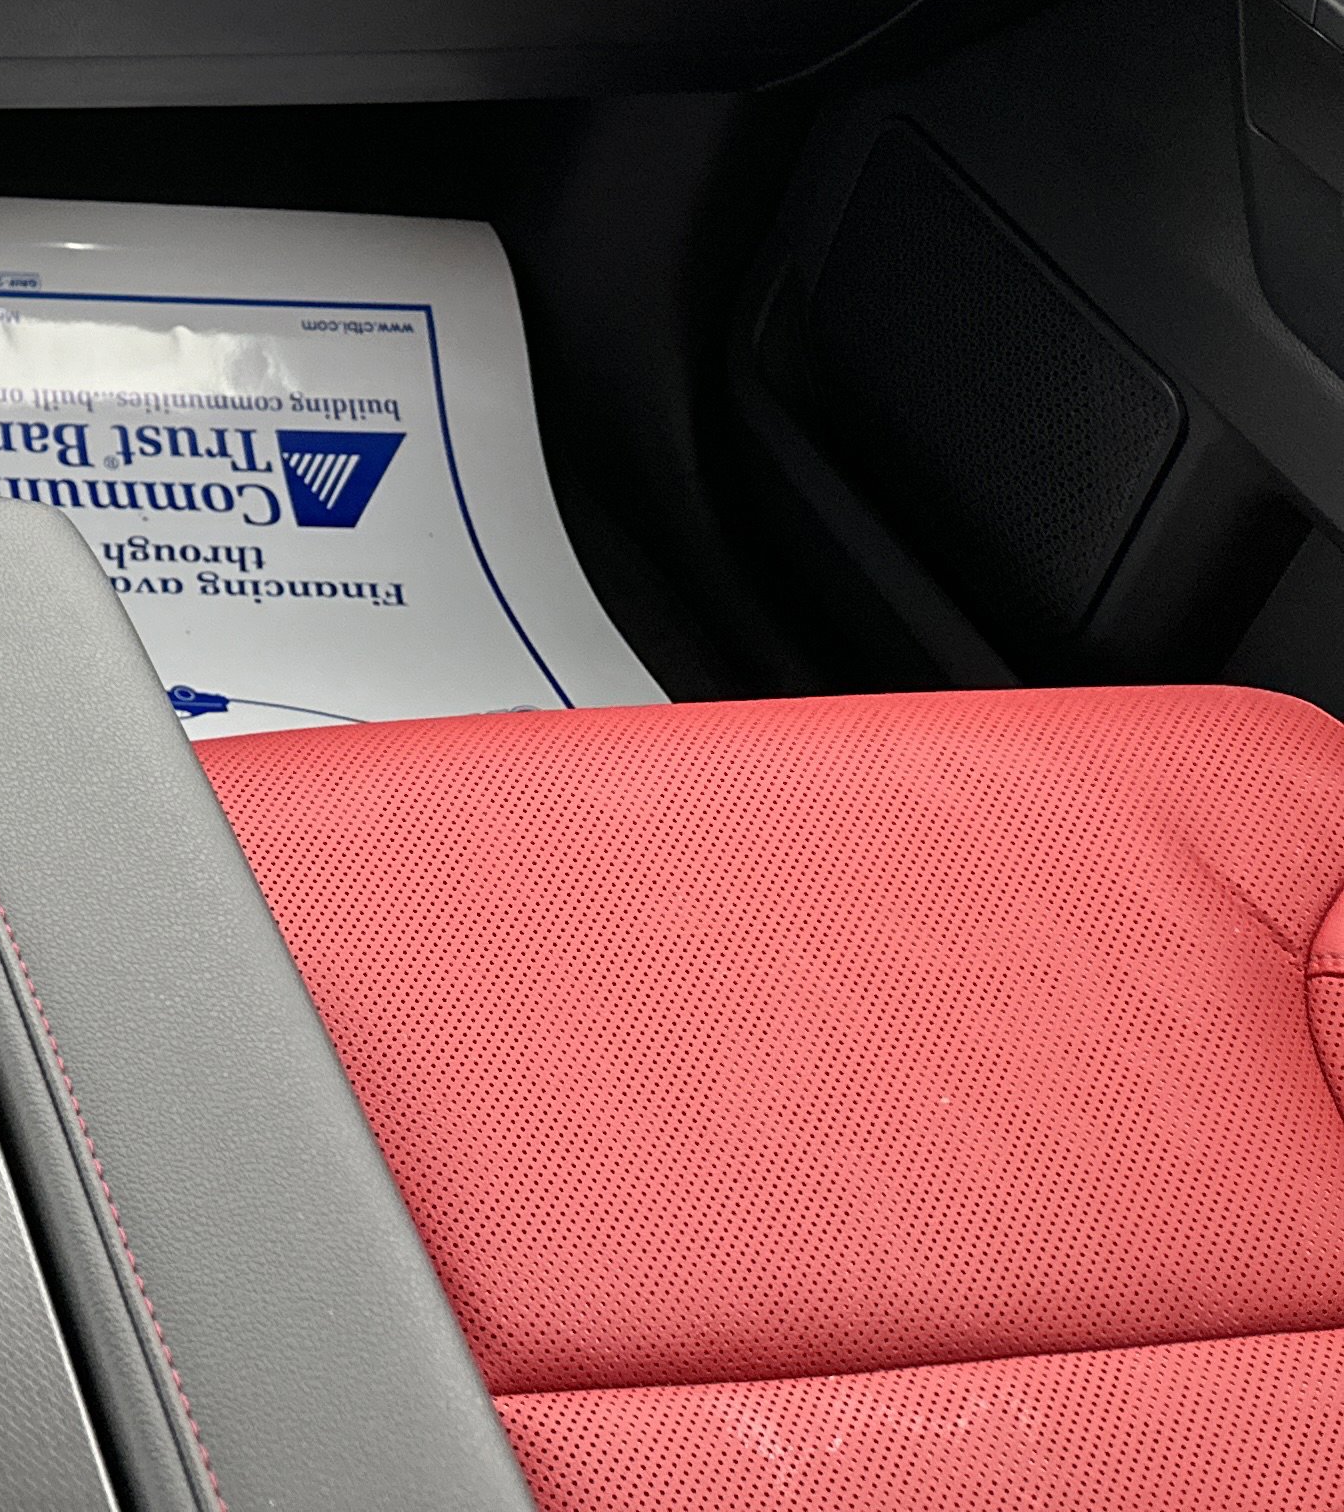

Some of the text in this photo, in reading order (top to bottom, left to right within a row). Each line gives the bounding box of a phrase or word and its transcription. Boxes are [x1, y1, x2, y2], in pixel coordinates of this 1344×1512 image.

[302, 318, 414, 334] www.ctbi.com
[289, 393, 401, 421] building
[100, 536, 266, 572] through
[197, 570, 409, 607] Financing
